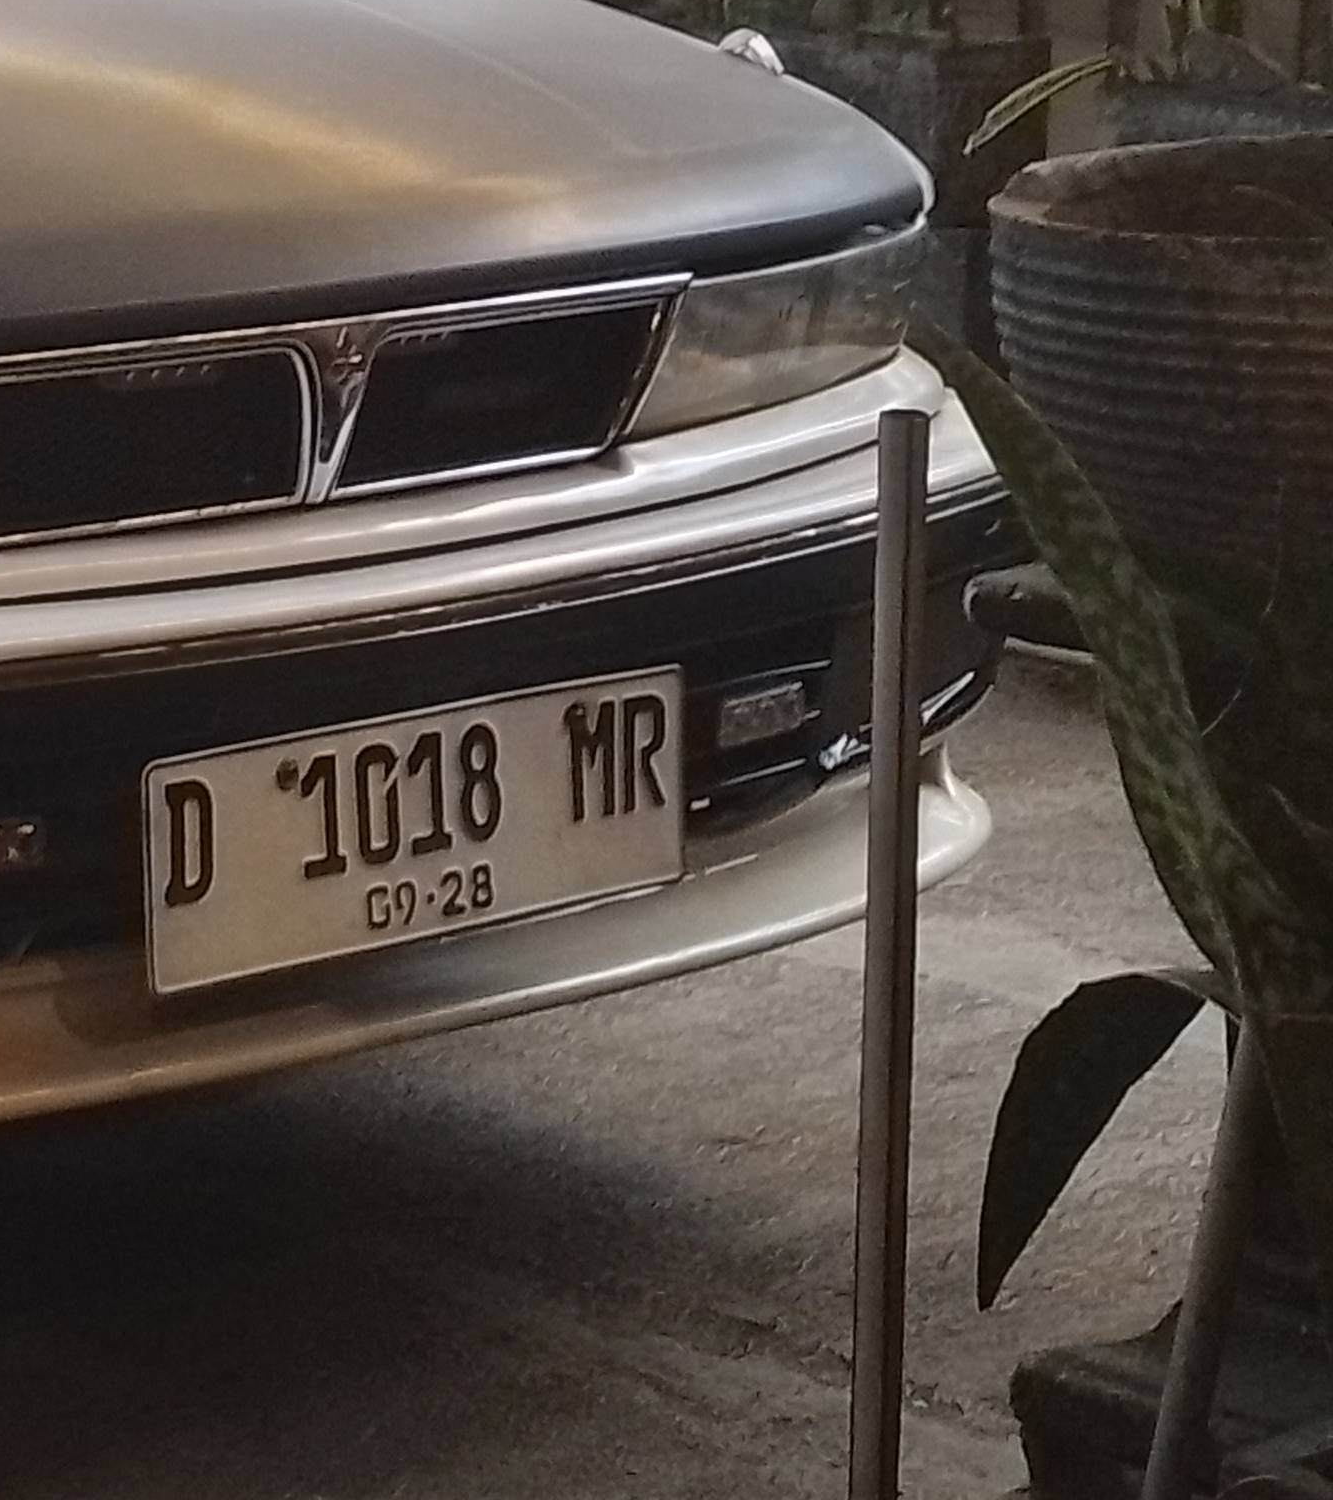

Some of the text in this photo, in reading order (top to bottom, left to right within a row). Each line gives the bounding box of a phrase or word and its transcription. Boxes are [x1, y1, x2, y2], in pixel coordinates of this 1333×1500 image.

[164, 693, 667, 907] D 1018 MR
